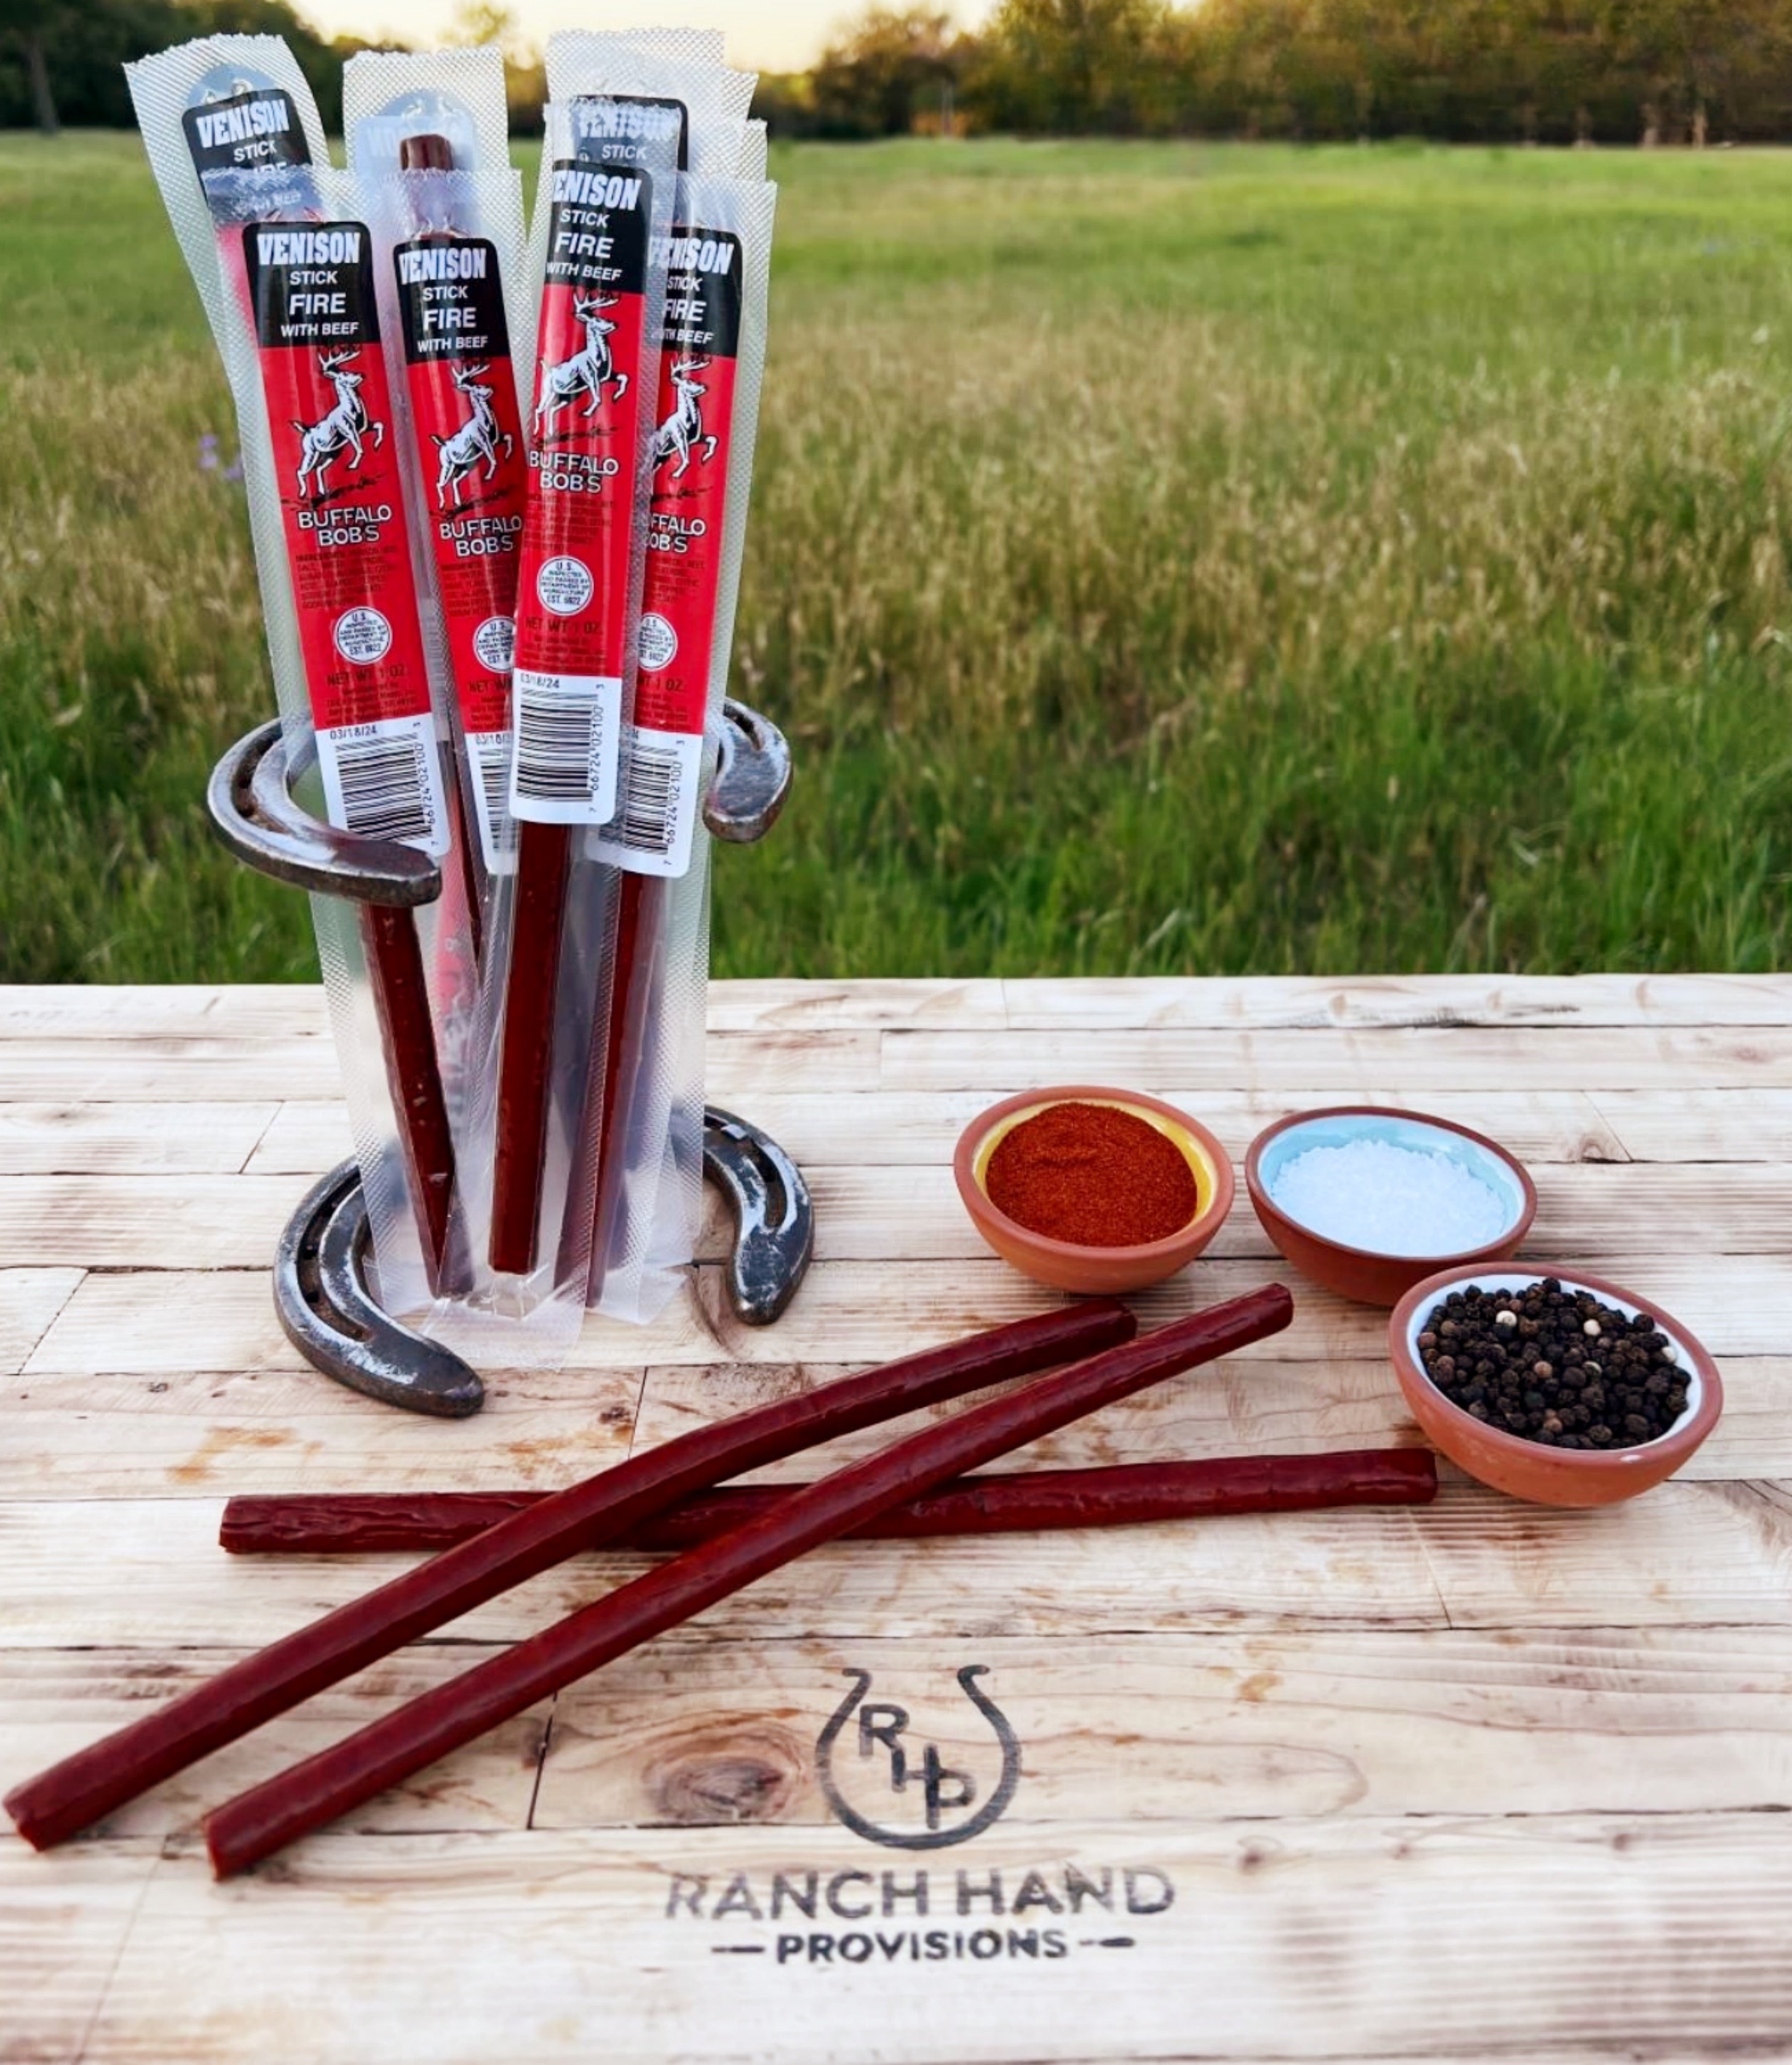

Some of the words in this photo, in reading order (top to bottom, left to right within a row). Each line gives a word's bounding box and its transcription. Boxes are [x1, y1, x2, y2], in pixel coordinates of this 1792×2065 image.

[196, 98, 290, 148] VENISON
[234, 140, 277, 162] STICK
[601, 144, 647, 160] STICK
[553, 170, 642, 211] ENISON
[560, 209, 611, 228] STICK
[257, 232, 360, 265] VENISON
[554, 231, 615, 259] FIRE
[289, 270, 338, 285] STICK
[398, 247, 486, 285] VENISON
[545, 261, 580, 276] WITH
[582, 265, 623, 281] BEEF
[422, 285, 469, 301] STICK
[667, 276, 704, 292] STICK
[288, 292, 346, 316] FIRE
[662, 298, 707, 321] FIRE
[280, 322, 318, 338] WITH
[322, 321, 360, 336] BEEF
[422, 307, 477, 331] FIRE
[416, 337, 452, 353] WITH
[456, 336, 490, 349] BEEF
[676, 328, 715, 344] BEEF
[529, 450, 620, 476] BUFFALO
[298, 504, 392, 530] BUFFALO
[438, 515, 523, 540] BUFFALO
[330, 724, 378, 741] 03/18/24
[665, 1869, 930, 1920] RANCH
[956, 1864, 1175, 1916] HAND
[776, 1928, 1068, 1965] PROVISIONS
